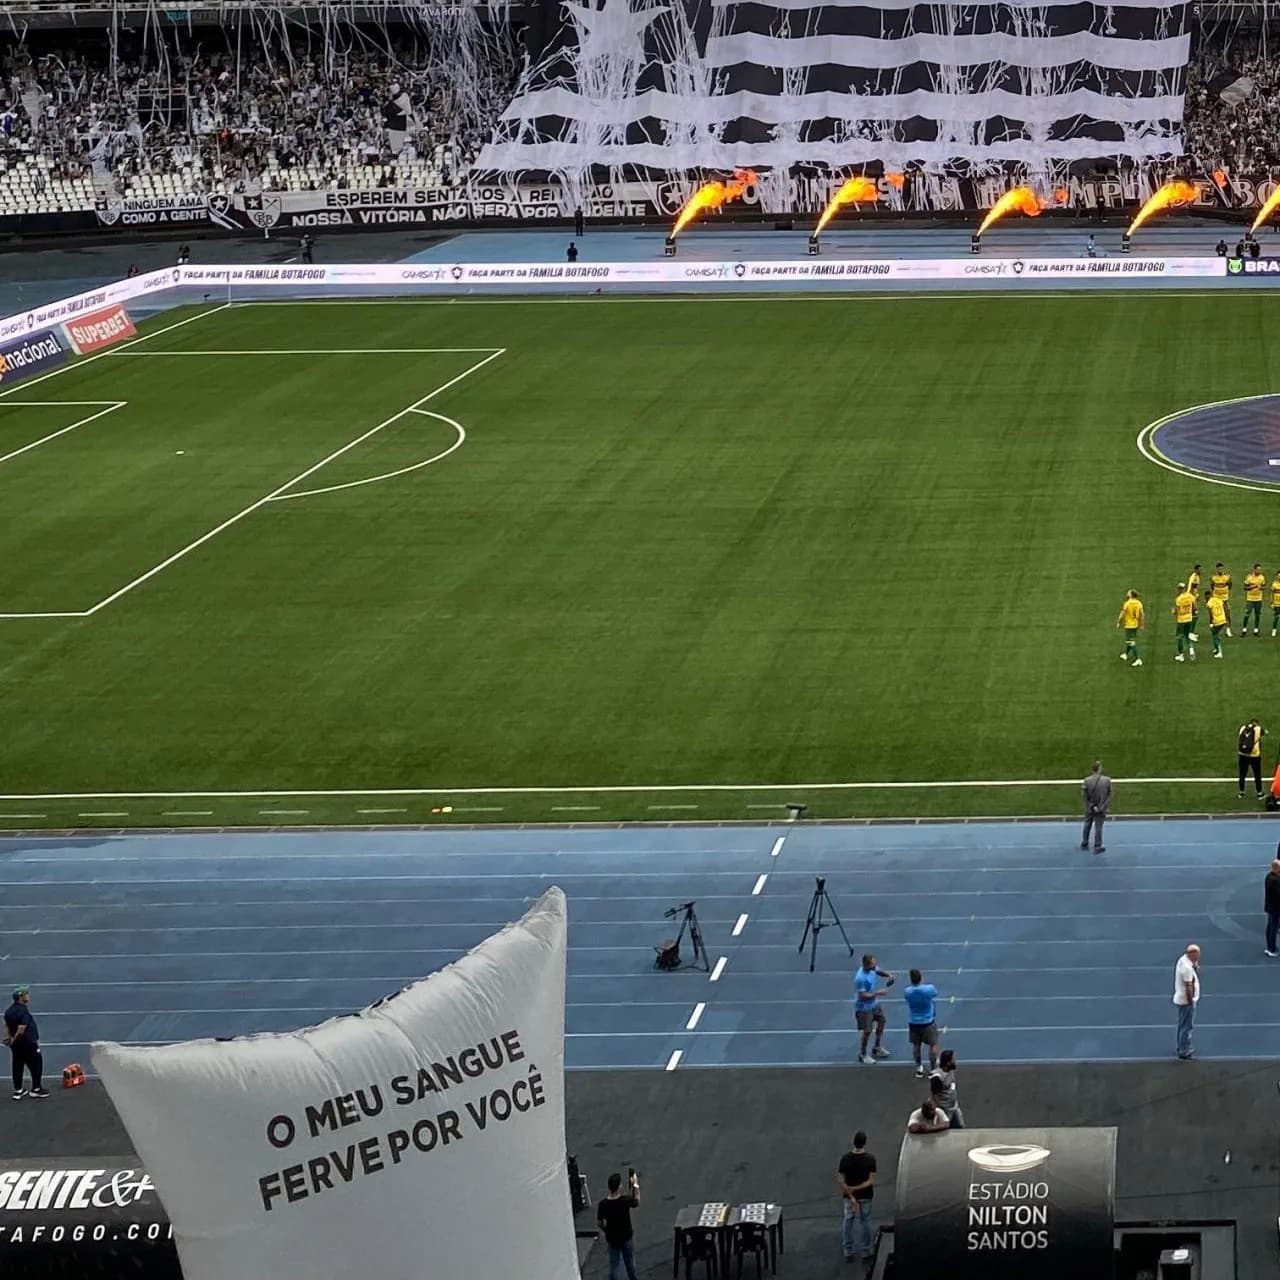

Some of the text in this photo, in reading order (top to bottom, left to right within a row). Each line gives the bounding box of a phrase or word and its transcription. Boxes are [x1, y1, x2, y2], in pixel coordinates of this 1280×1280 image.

[178, 197, 204, 208] AMA
[326, 191, 407, 206] ESPEREM
[122, 212, 157, 223] COMO
[159, 210, 168, 221] A
[170, 208, 208, 221] GENTE
[292, 212, 353, 226] NOSSA
[360, 207, 426, 223] VITÓRIA
[281, 269, 326, 279] BOTAFOGO
[565, 266, 610, 278] BOTAFOGO
[847, 263, 890, 275] BOTAFOGO
[1122, 261, 1165, 272] BOTAFOGO
[71, 309, 130, 345] SUPERBET
[267, 1030, 525, 1149] O MEU SANGUE
[258, 1063, 546, 1211] FERVE POR VOCÊ
[968, 1180, 1049, 1200] ESTÁDIO
[968, 1205, 1047, 1226] NILTON
[967, 1230, 1049, 1250] SANTOS
